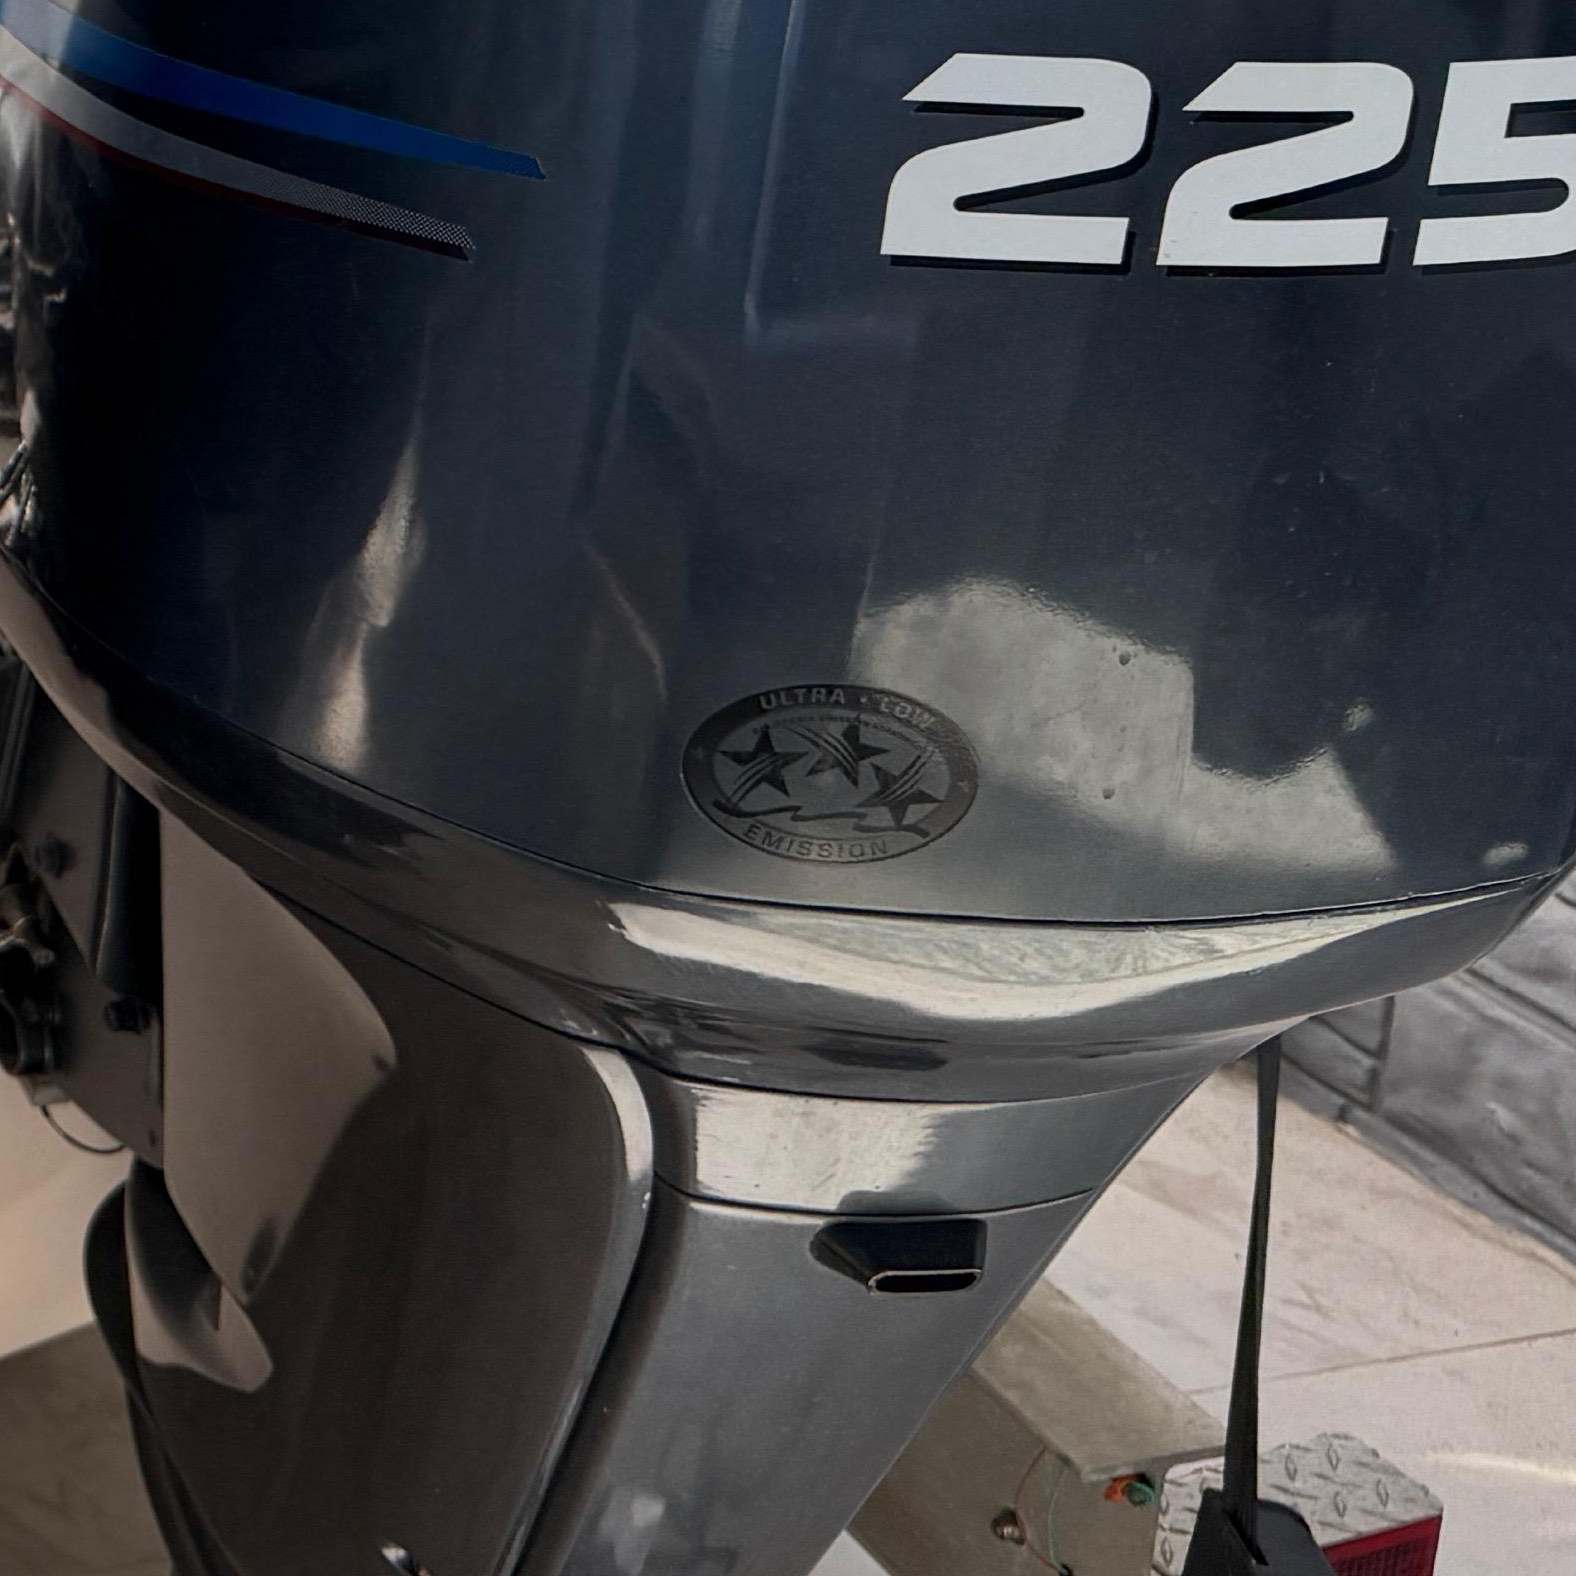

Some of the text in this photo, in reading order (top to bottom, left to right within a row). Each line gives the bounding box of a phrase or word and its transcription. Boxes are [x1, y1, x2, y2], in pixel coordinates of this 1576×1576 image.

[880, 52, 1576, 269] 225
[759, 687, 846, 711] ULTRA
[743, 822, 889, 860] EMISSION
